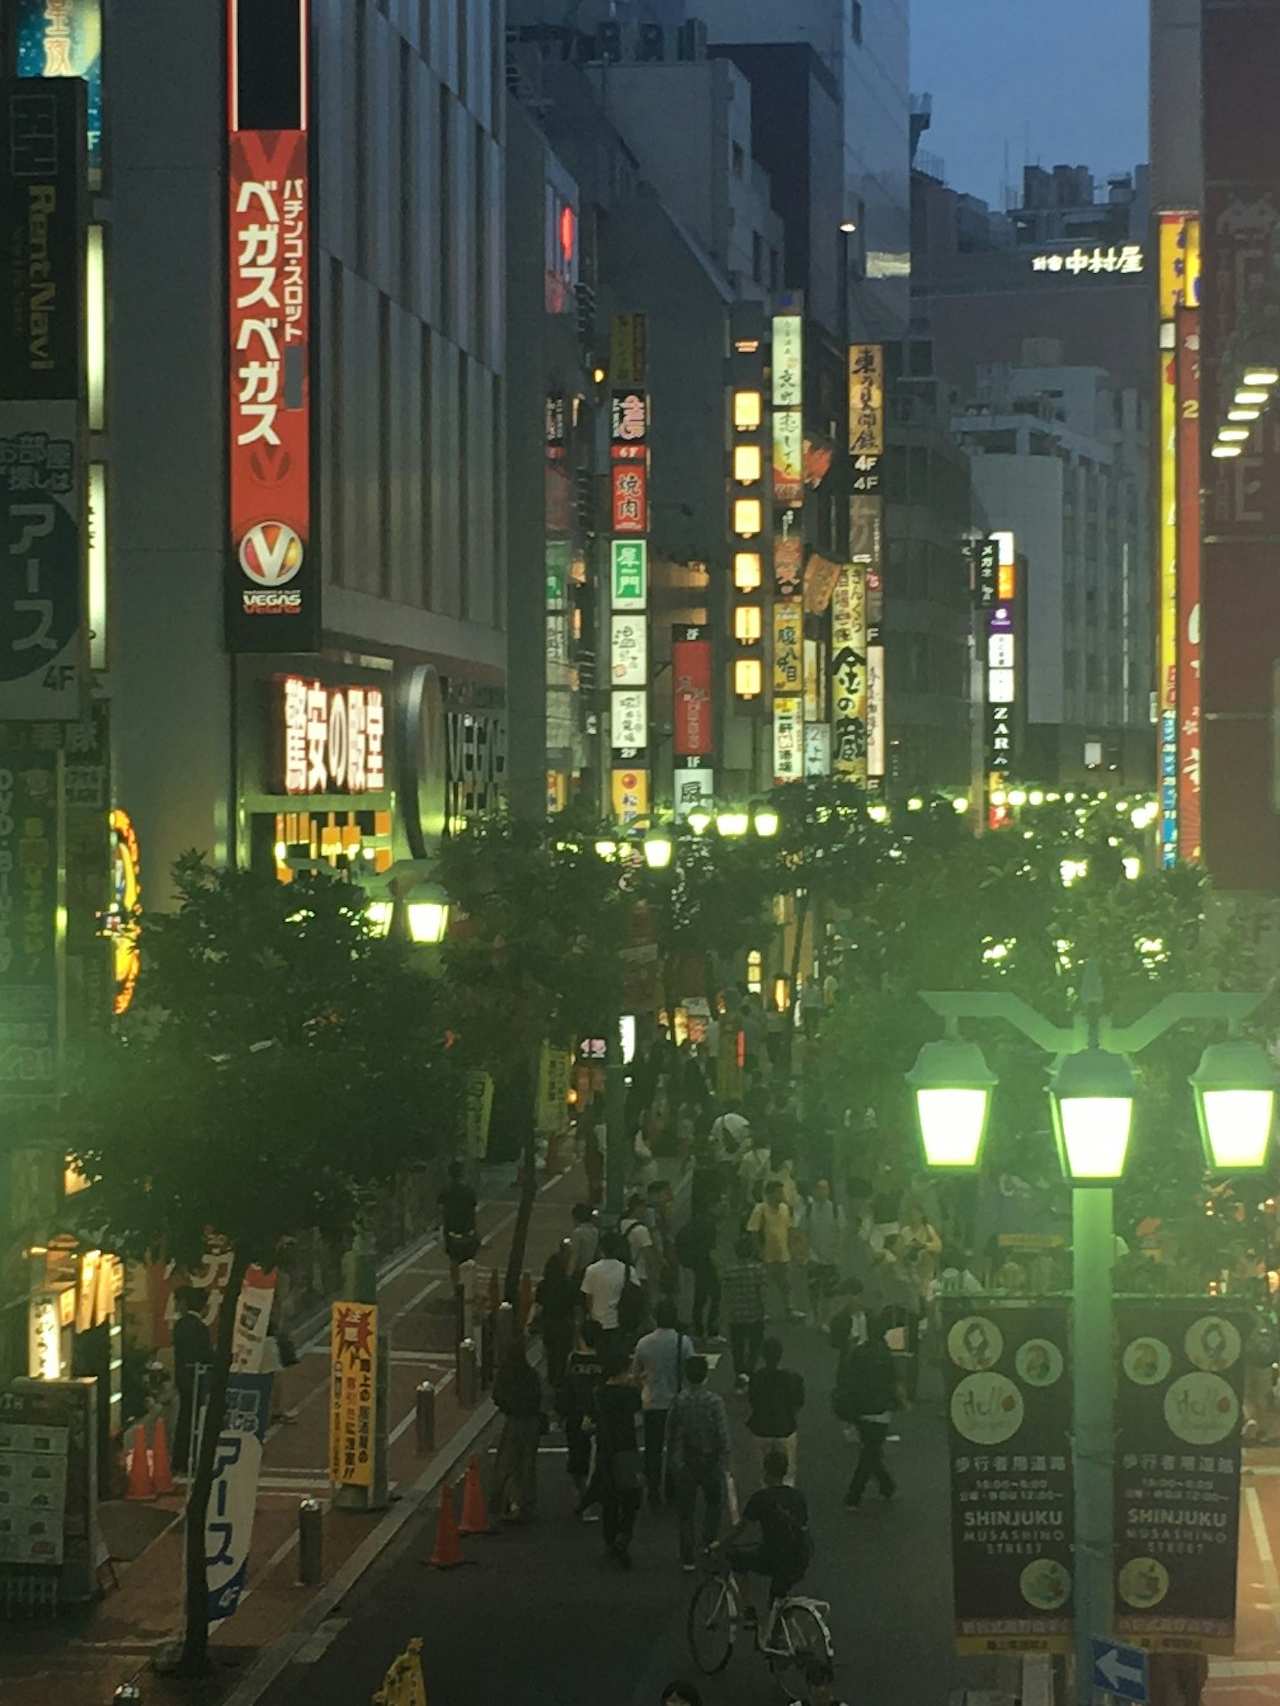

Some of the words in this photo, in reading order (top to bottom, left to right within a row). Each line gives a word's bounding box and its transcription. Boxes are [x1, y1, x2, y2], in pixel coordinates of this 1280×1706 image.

[236, 180, 282, 447] ベガスベガス
[8, 503, 59, 652] アース
[284, 677, 385, 795] 驚安の殿堂
[963, 1510, 1064, 1527] SHINJUKU
[1126, 1507, 1228, 1528] SHINJUKU
[962, 1529, 1066, 1543] MUSASHINO
[1125, 1527, 1228, 1545] MUSASHINO
[986, 1542, 1044, 1555] STREET
